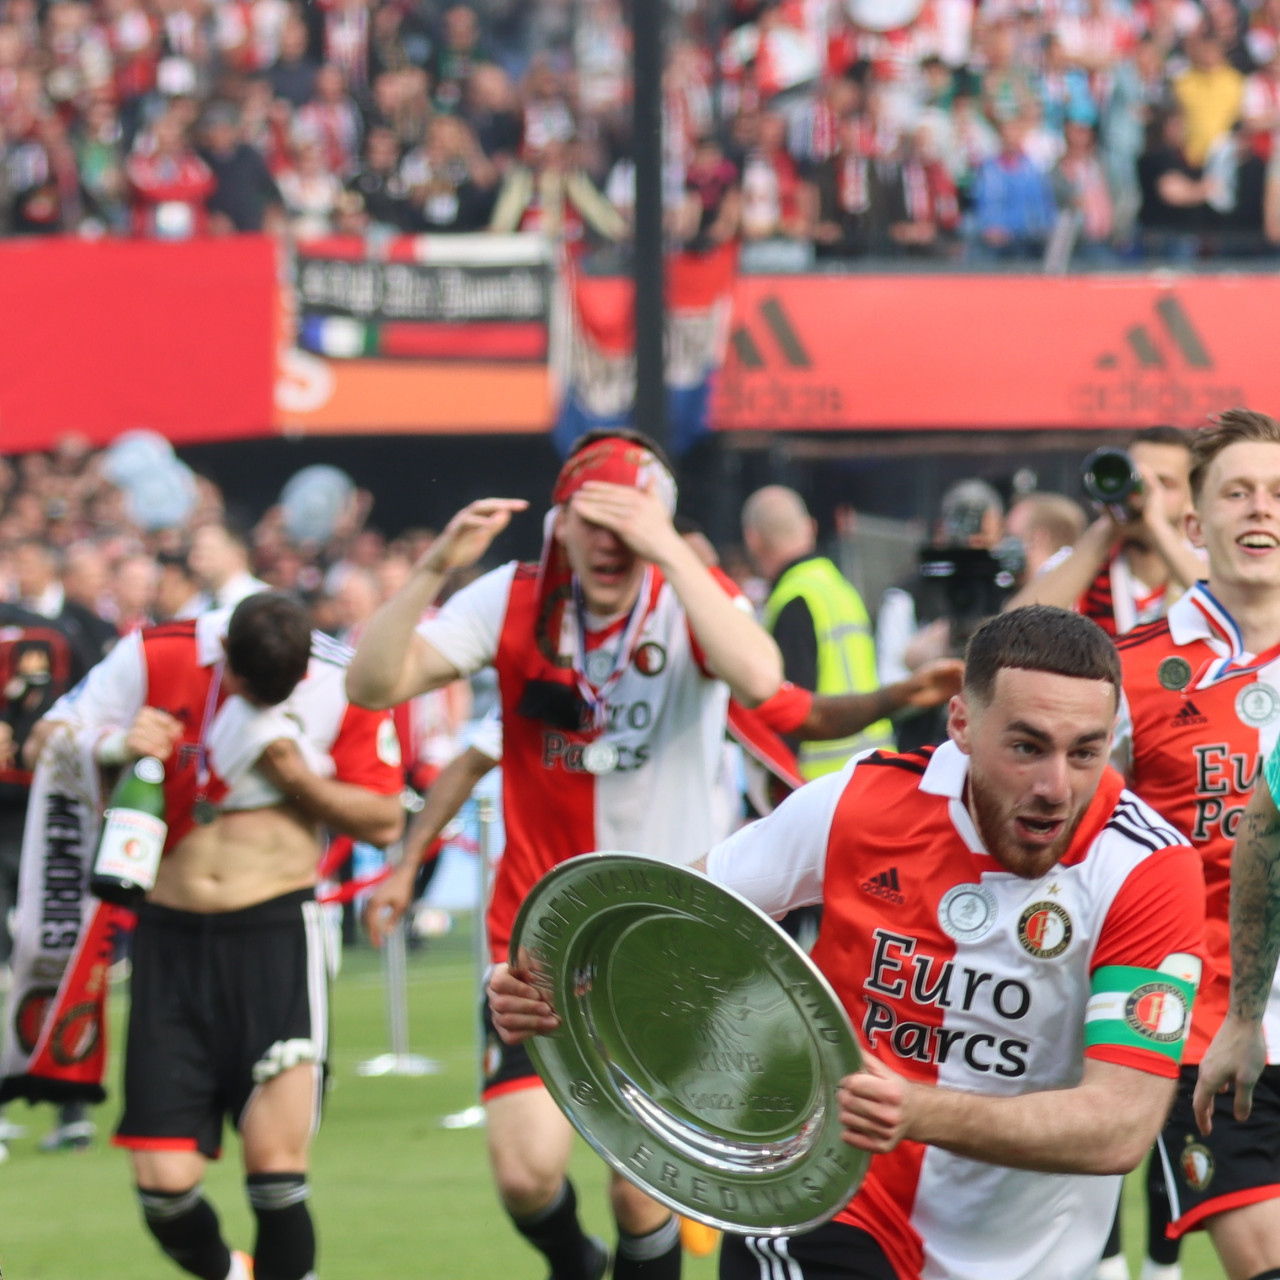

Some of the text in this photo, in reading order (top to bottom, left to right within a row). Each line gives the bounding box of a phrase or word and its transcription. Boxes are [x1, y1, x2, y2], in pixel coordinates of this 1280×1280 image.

[42, 793, 82, 949] MEMORIES
[860, 882, 905, 906] adidas
[863, 928, 1032, 1020] Euro
[863, 995, 1031, 1078] Parcs
[628, 1143, 851, 1217] EREDIVISIE
